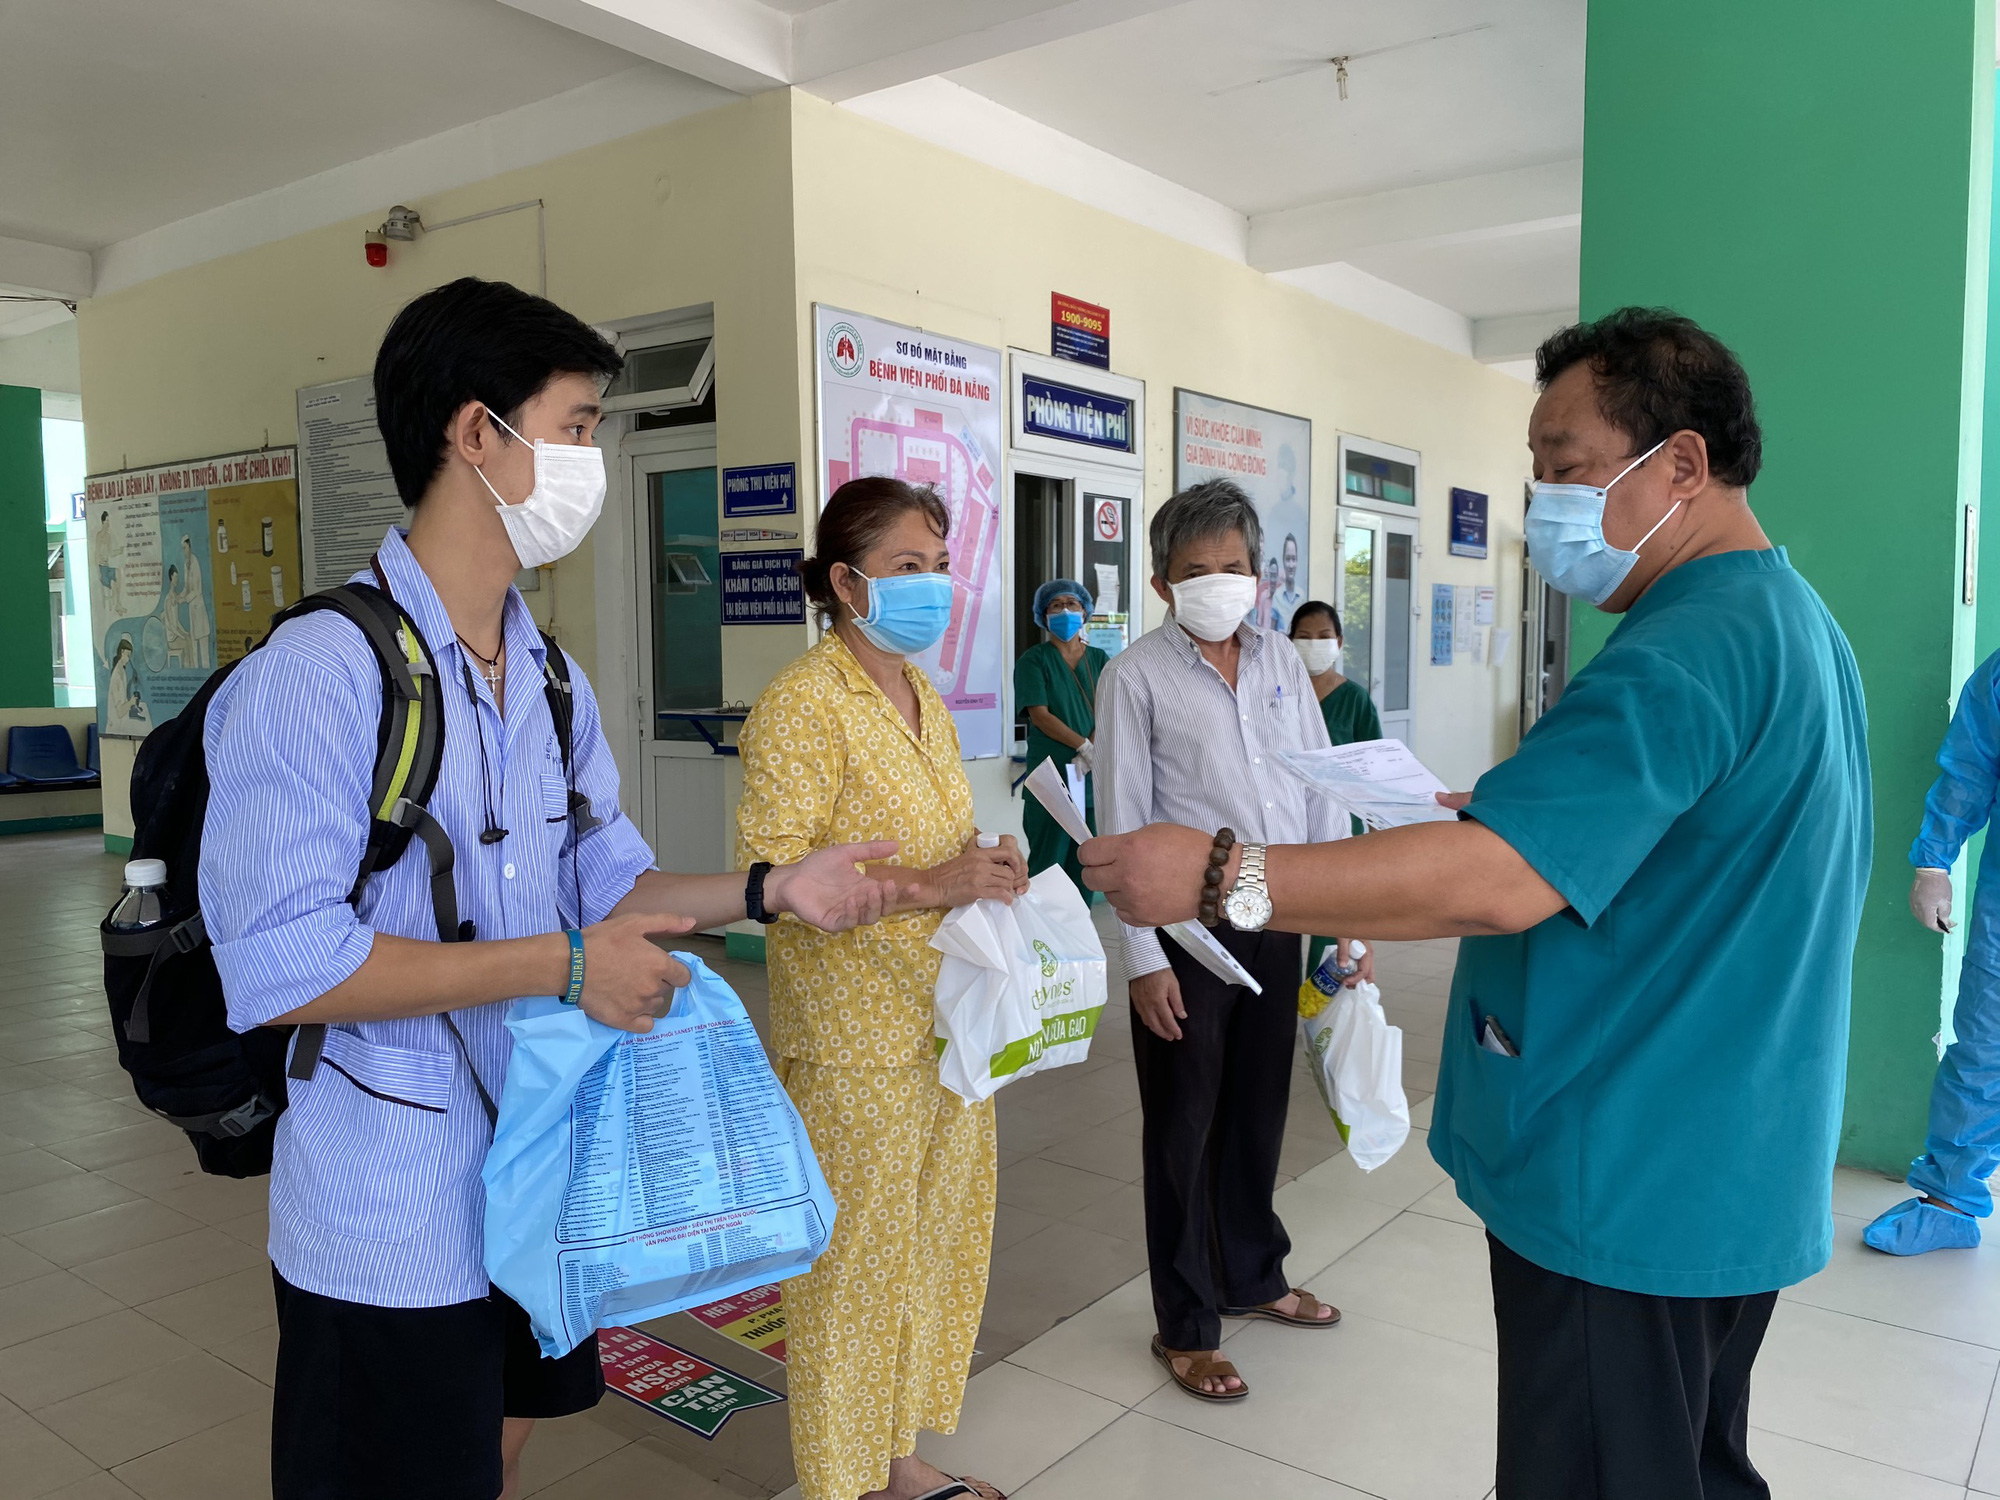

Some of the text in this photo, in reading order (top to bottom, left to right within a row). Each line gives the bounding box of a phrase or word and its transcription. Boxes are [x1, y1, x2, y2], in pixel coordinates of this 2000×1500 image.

[1061, 310, 1102, 332] 1900-9095
[896, 341, 967, 370] SƠ ĐỒ MẶT BẰNG
[870, 358, 897, 383] BỆNH
[900, 365, 923, 389] VIỆN
[925, 369, 948, 392] PHỔI
[950, 376, 962, 396] ĐÀ
[965, 377, 990, 401] NẴNG
[1027, 391, 1127, 440] PHÒNG VIỆN PHÍ
[1185, 444, 1197, 463] GIA
[159, 470, 181, 491] KHÔNG
[183, 470, 191, 488] DI
[727, 471, 791, 493] PHÒNG THU VIỆN PHÍ
[732, 558, 791, 571] BẢNG GIÁ DỊCH VỤ
[725, 574, 800, 595] KHÁM CHỮA BỆNH
[726, 602, 734, 619] TẠI
[735, 599, 749, 619] BỆNH
[750, 599, 762, 618] VIỆN
[763, 596, 776, 615] PHỔI
[777, 598, 784, 615] ĐÀ
[572, 947, 584, 982] DURANT
[674, 1027, 694, 1036] SANEST
[694, 1023, 708, 1032] TRÊN
[627, 1208, 758, 1243] HỆ THỐNG SHOWROOM SIÊU THỊ TRÊN TOÀN QUỐC
[645, 1219, 743, 1247] VĂN PHÒNG ĐẠI DIỆN TẠI NƯỚC NGOÀI
[702, 1302, 737, 1319] HEN
[741, 1284, 781, 1303] COPD
[743, 1302, 768, 1314] 10m
[624, 1339, 651, 1353] III
[615, 1354, 650, 1370] 15m
[625, 1360, 666, 1379] KHOA
[624, 1359, 695, 1394] HSCC
[661, 1375, 692, 1391] 25m
[660, 1374, 727, 1408] CĂN
[681, 1385, 737, 1412] TIN
[707, 1396, 739, 1413] 35m
